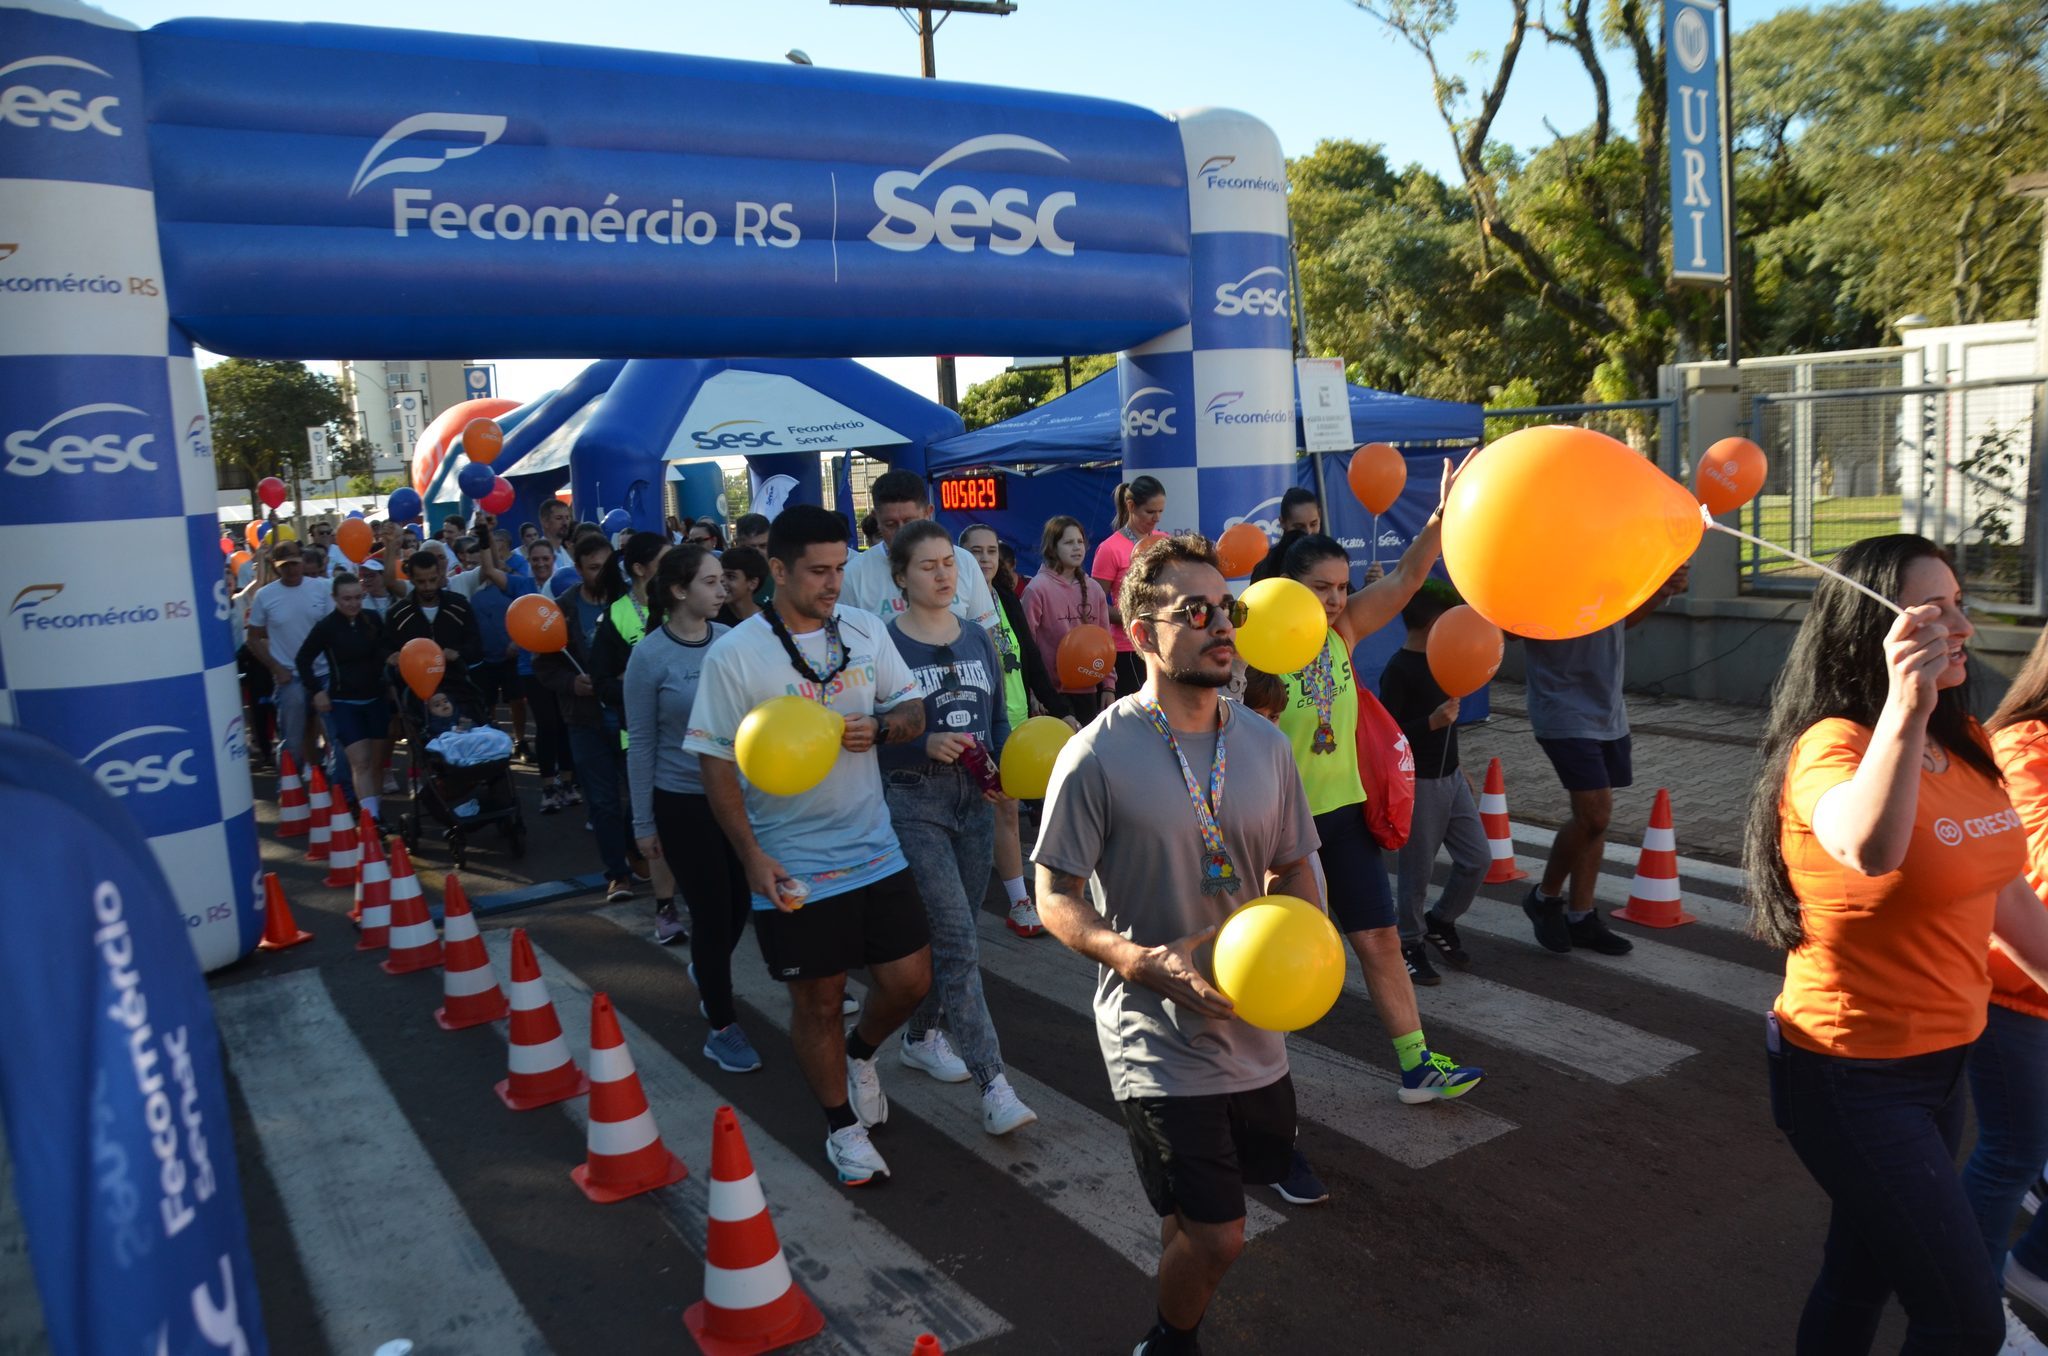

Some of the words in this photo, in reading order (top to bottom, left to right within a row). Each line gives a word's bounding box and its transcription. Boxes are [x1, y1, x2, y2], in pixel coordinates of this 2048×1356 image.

[0, 85, 122, 136] esc
[1208, 175, 1280, 193] Fecomércio
[1679, 85, 1711, 268] URI
[393, 188, 717, 247] Fecomércio
[735, 201, 801, 248] RS
[867, 171, 1075, 256] Sesc
[128, 277, 159, 296] RS
[1215, 409, 1286, 425] Fecomércio
[691, 430, 783, 450] Sesc
[787, 420, 865, 435] Fecomércio
[4, 429, 158, 476] Sesc
[313, 443, 325, 477] URI
[941, 478, 996, 509] 005829
[22, 603, 159, 631] Fecomércio
[165, 600, 191, 621] RS
[785, 665, 875, 700] Ausmo
[93, 748, 198, 798] esc
[207, 902, 231, 924] RS
[93, 880, 196, 1238] Fecomércio
